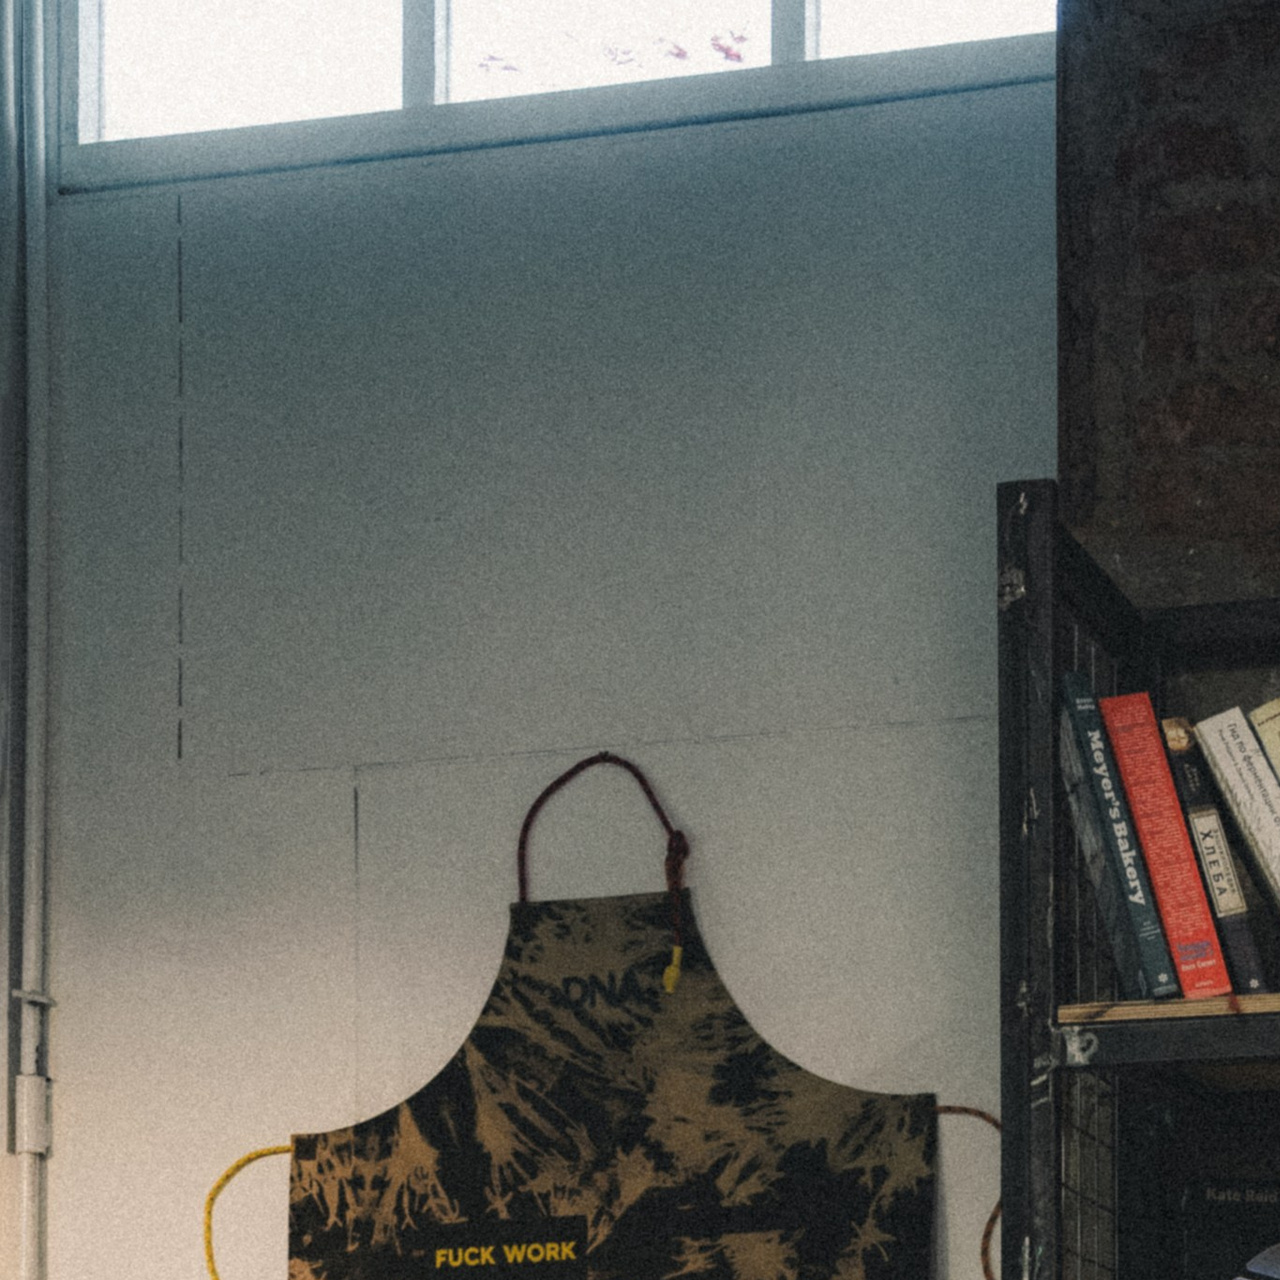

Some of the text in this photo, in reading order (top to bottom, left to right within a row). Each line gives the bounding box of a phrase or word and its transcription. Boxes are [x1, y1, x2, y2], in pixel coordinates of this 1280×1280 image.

[1087, 730, 1146, 905] Meyer's Bakery
[1200, 830, 1227, 896] ХЛЕБА
[435, 1241, 577, 1269] FUCK WORK
